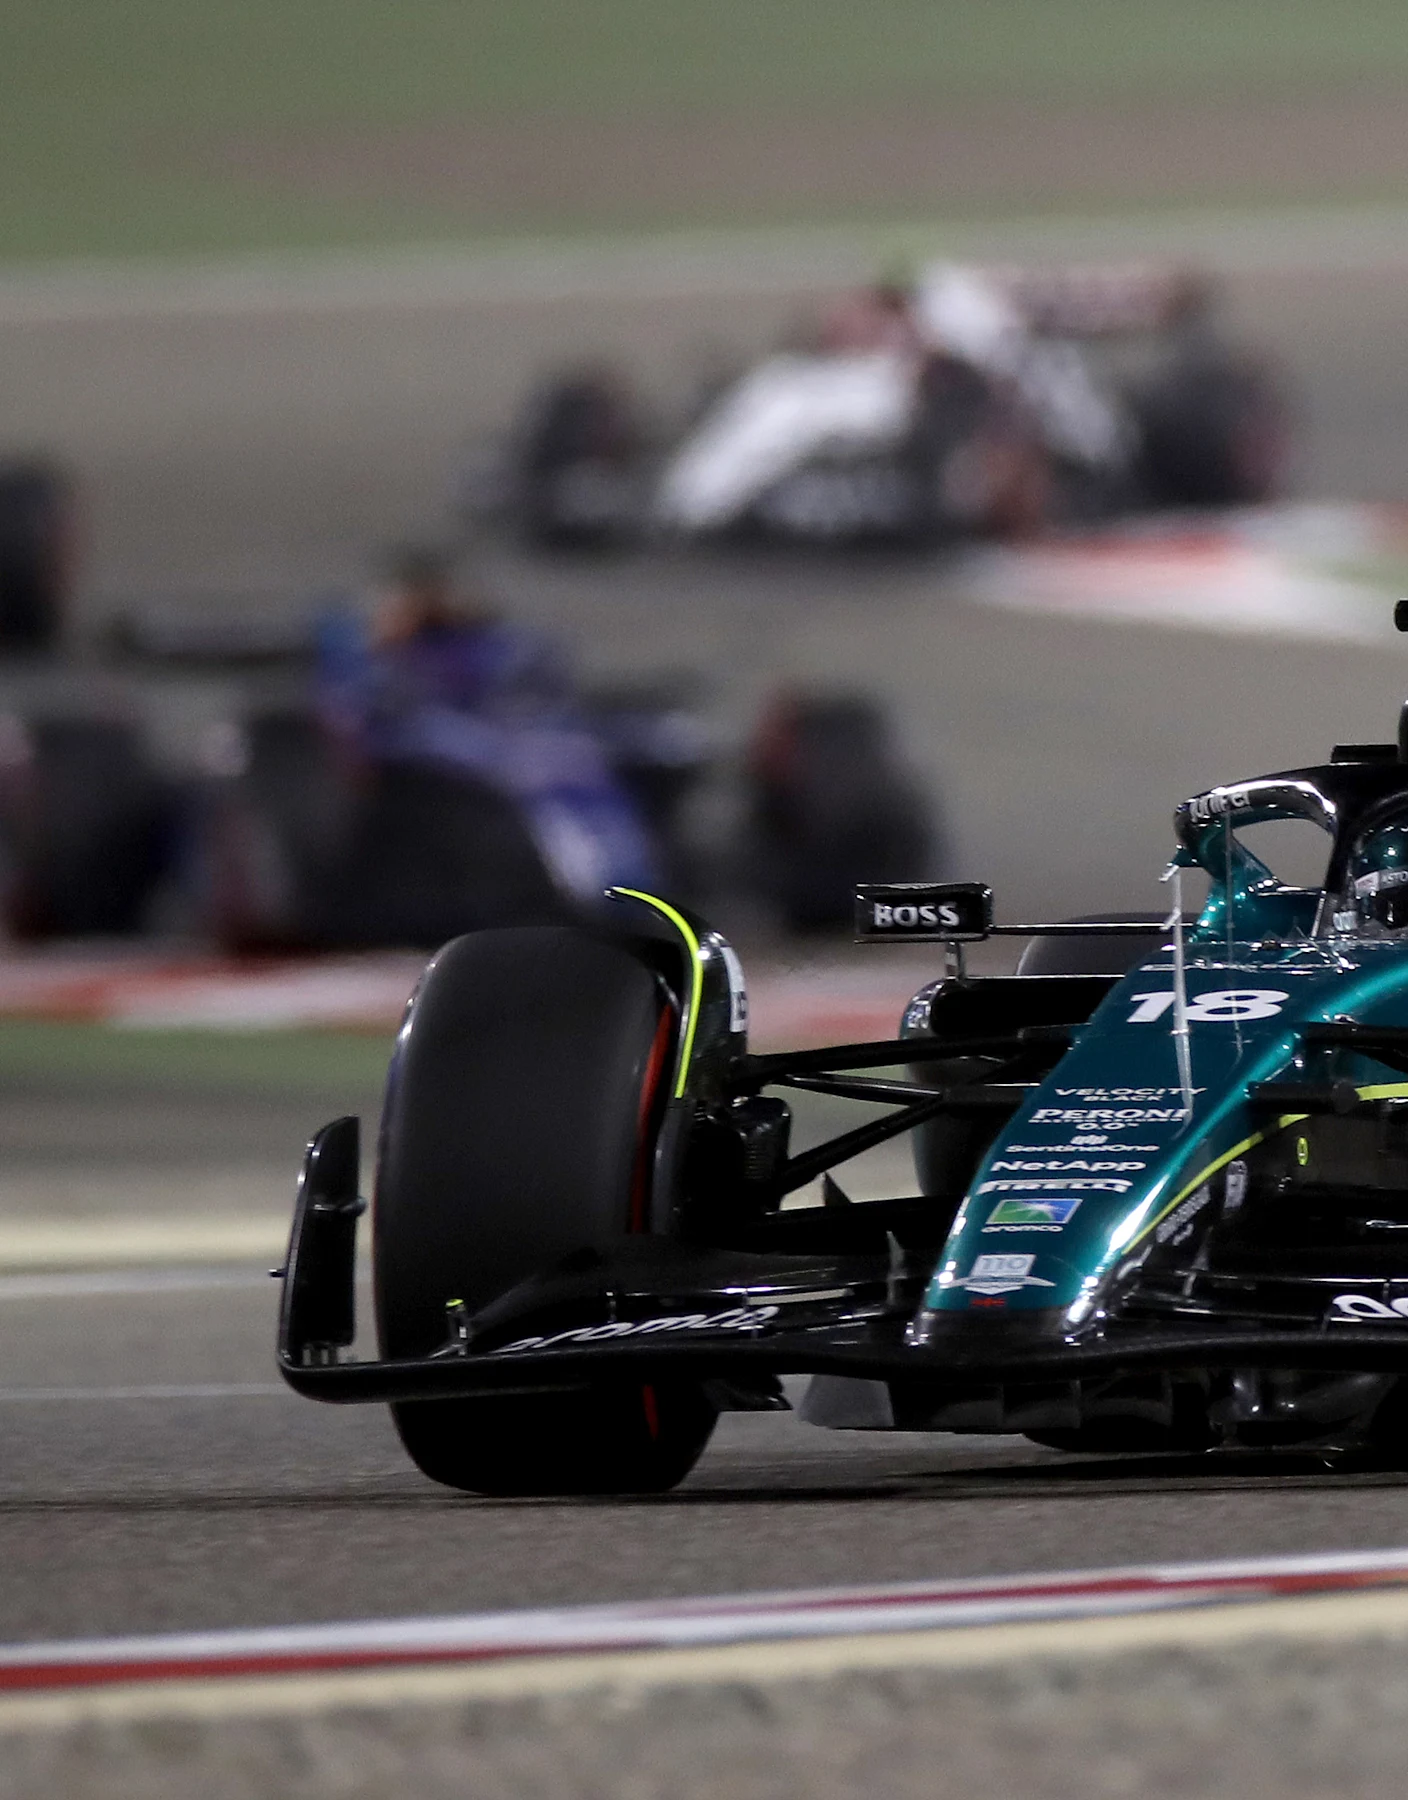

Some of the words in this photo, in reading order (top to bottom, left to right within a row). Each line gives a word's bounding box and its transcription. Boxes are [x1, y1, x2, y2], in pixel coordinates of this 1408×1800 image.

[873, 902, 960, 927] BOSS
[1126, 989, 1291, 1023] 18
[1055, 1087, 1208, 1096] VELOCITY
[1032, 1108, 1190, 1120] PERONI
[1005, 1144, 1160, 1154] SentinelOne
[990, 1160, 1147, 1173] NetApp
[975, 1178, 1134, 1196] PIRELLI
[981, 1225, 1064, 1233] aramco
[490, 1306, 780, 1354] aramco
